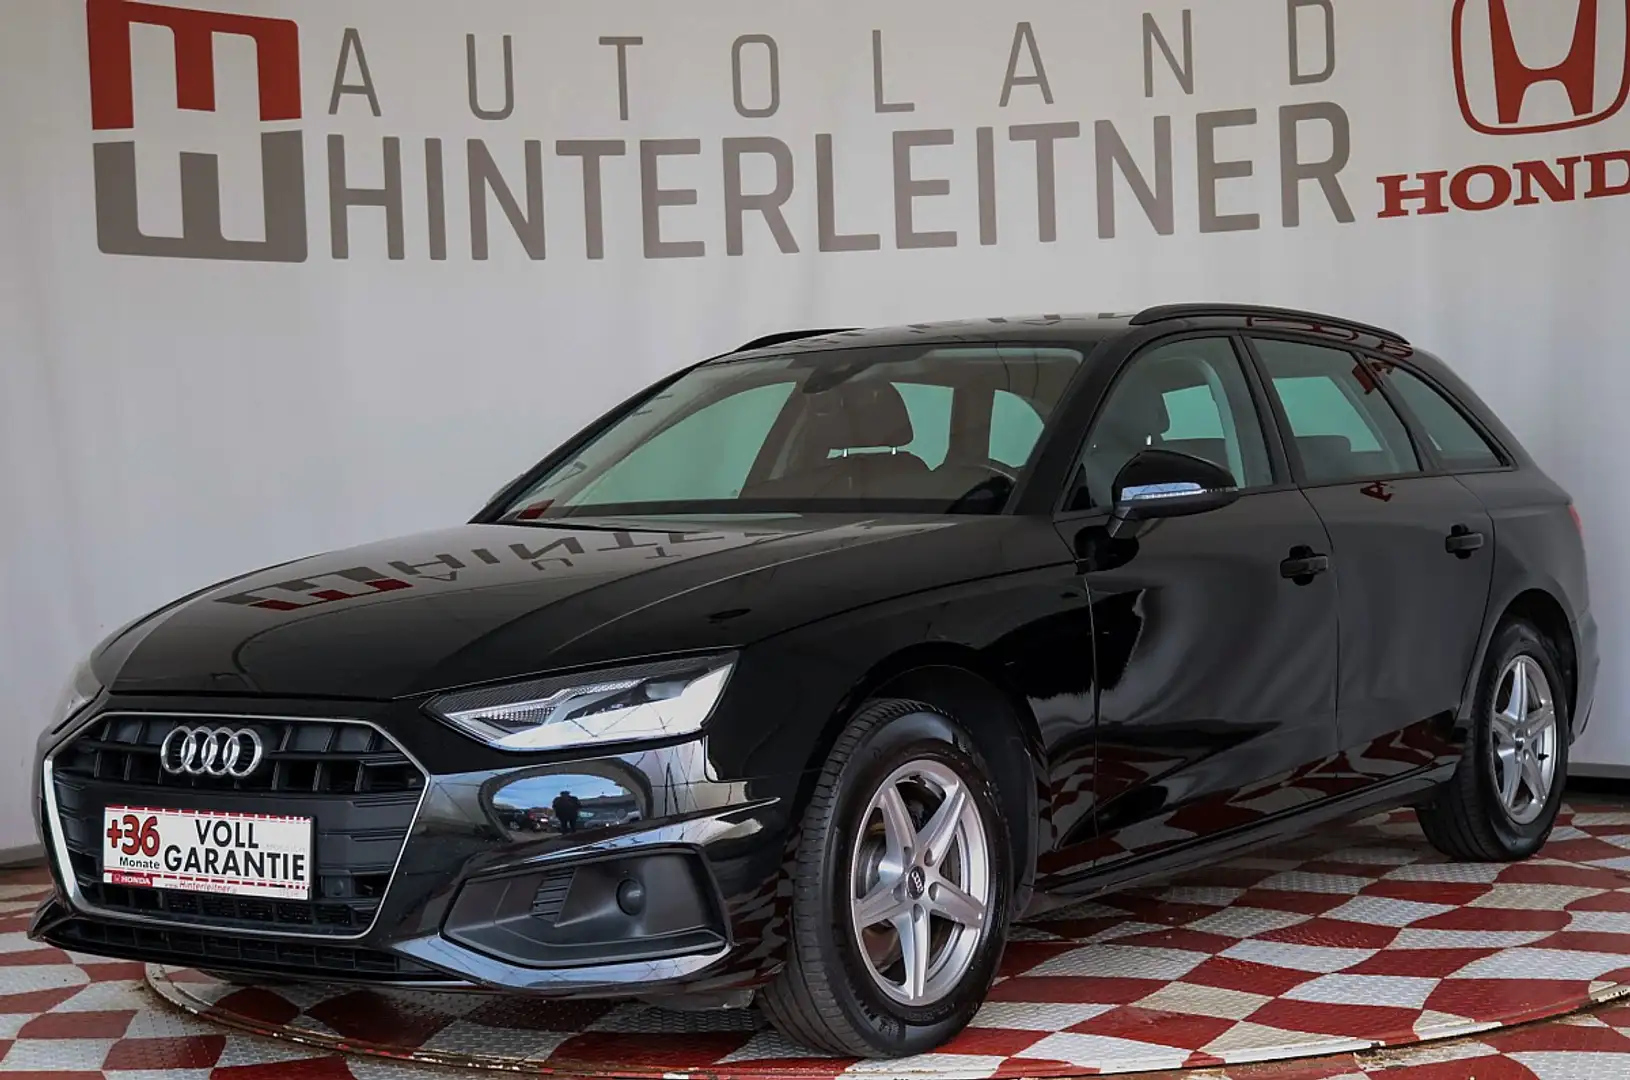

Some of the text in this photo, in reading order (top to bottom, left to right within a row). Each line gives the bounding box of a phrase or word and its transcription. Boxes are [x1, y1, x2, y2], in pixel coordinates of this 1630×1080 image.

[327, 101, 1355, 261] HINTERLEITNER
[107, 814, 160, 857] +36
[195, 819, 259, 849] VOLL
[119, 857, 160, 869] Monate
[164, 845, 305, 881] GARANTIE
[120, 876, 152, 885] HONDA
